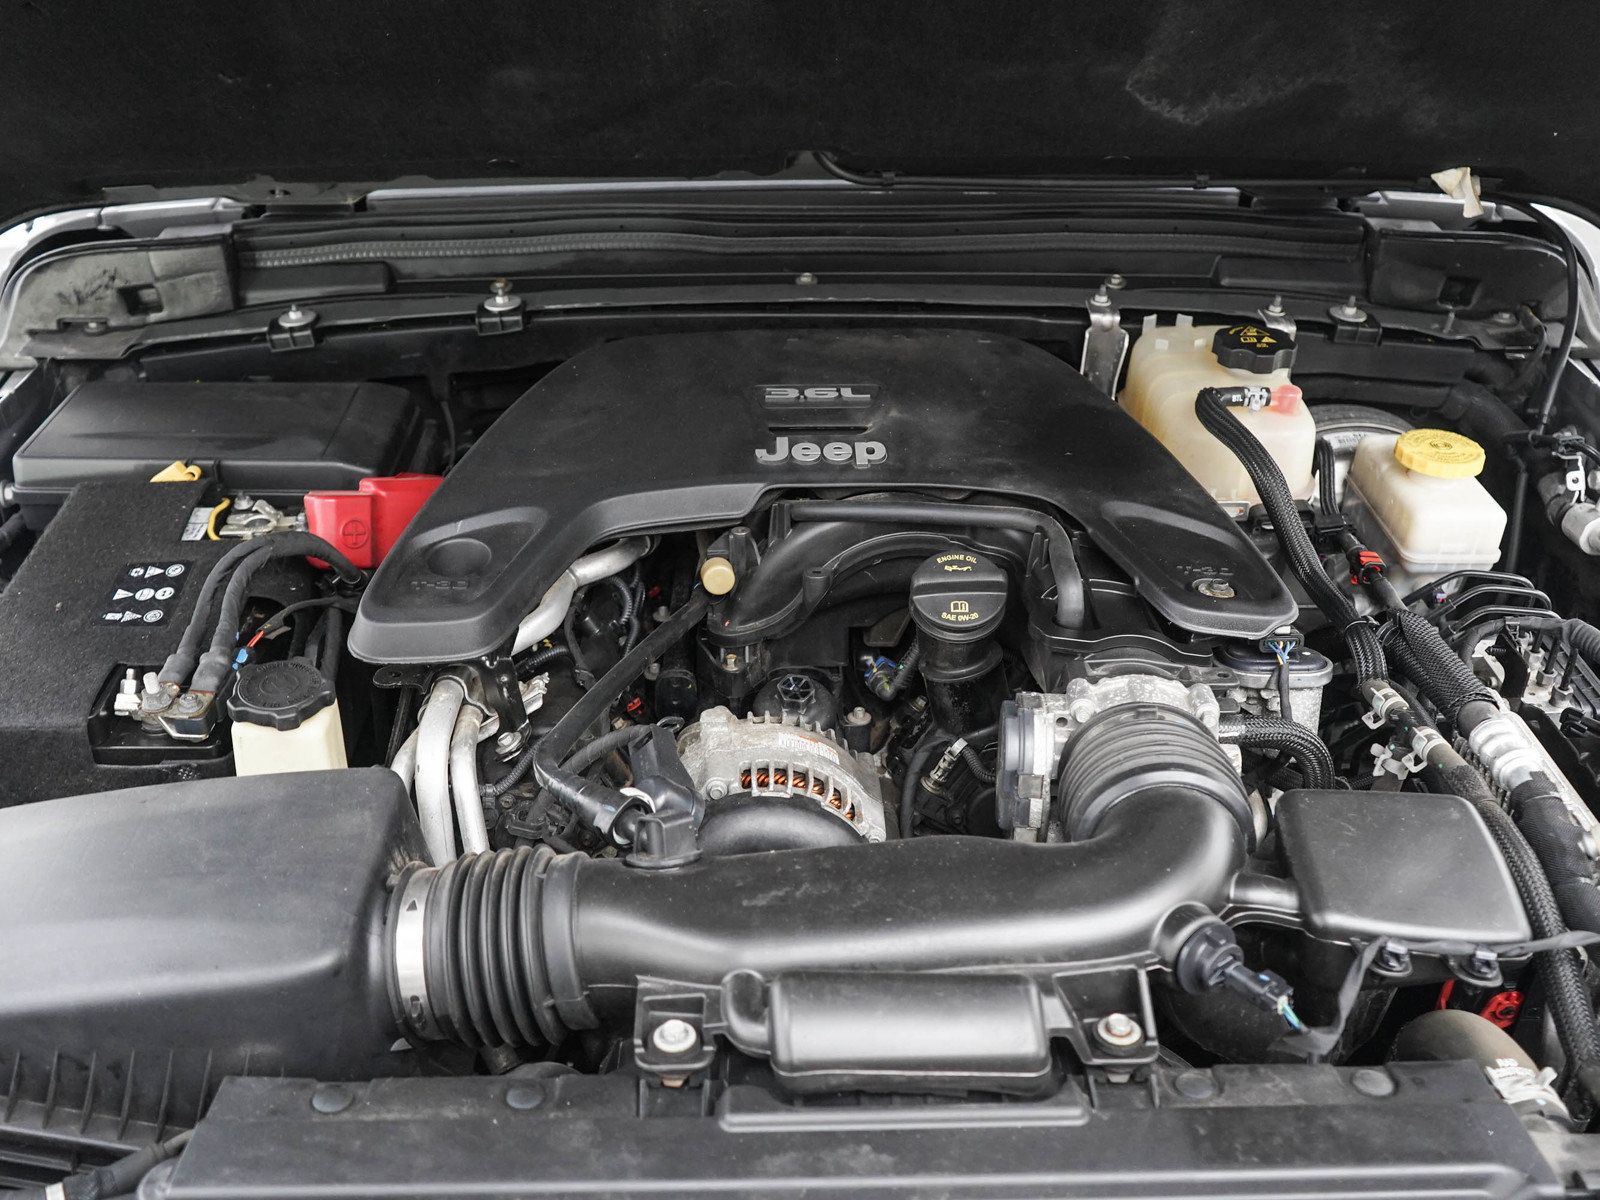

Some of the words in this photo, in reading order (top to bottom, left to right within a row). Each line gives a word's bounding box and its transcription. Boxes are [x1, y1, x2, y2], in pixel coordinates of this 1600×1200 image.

[764, 387, 871, 401] 3.6L
[755, 436, 887, 468] Jeep
[936, 554, 964, 564] ENGINE
[966, 556, 978, 564] OIL
[942, 612, 956, 620] SAE
